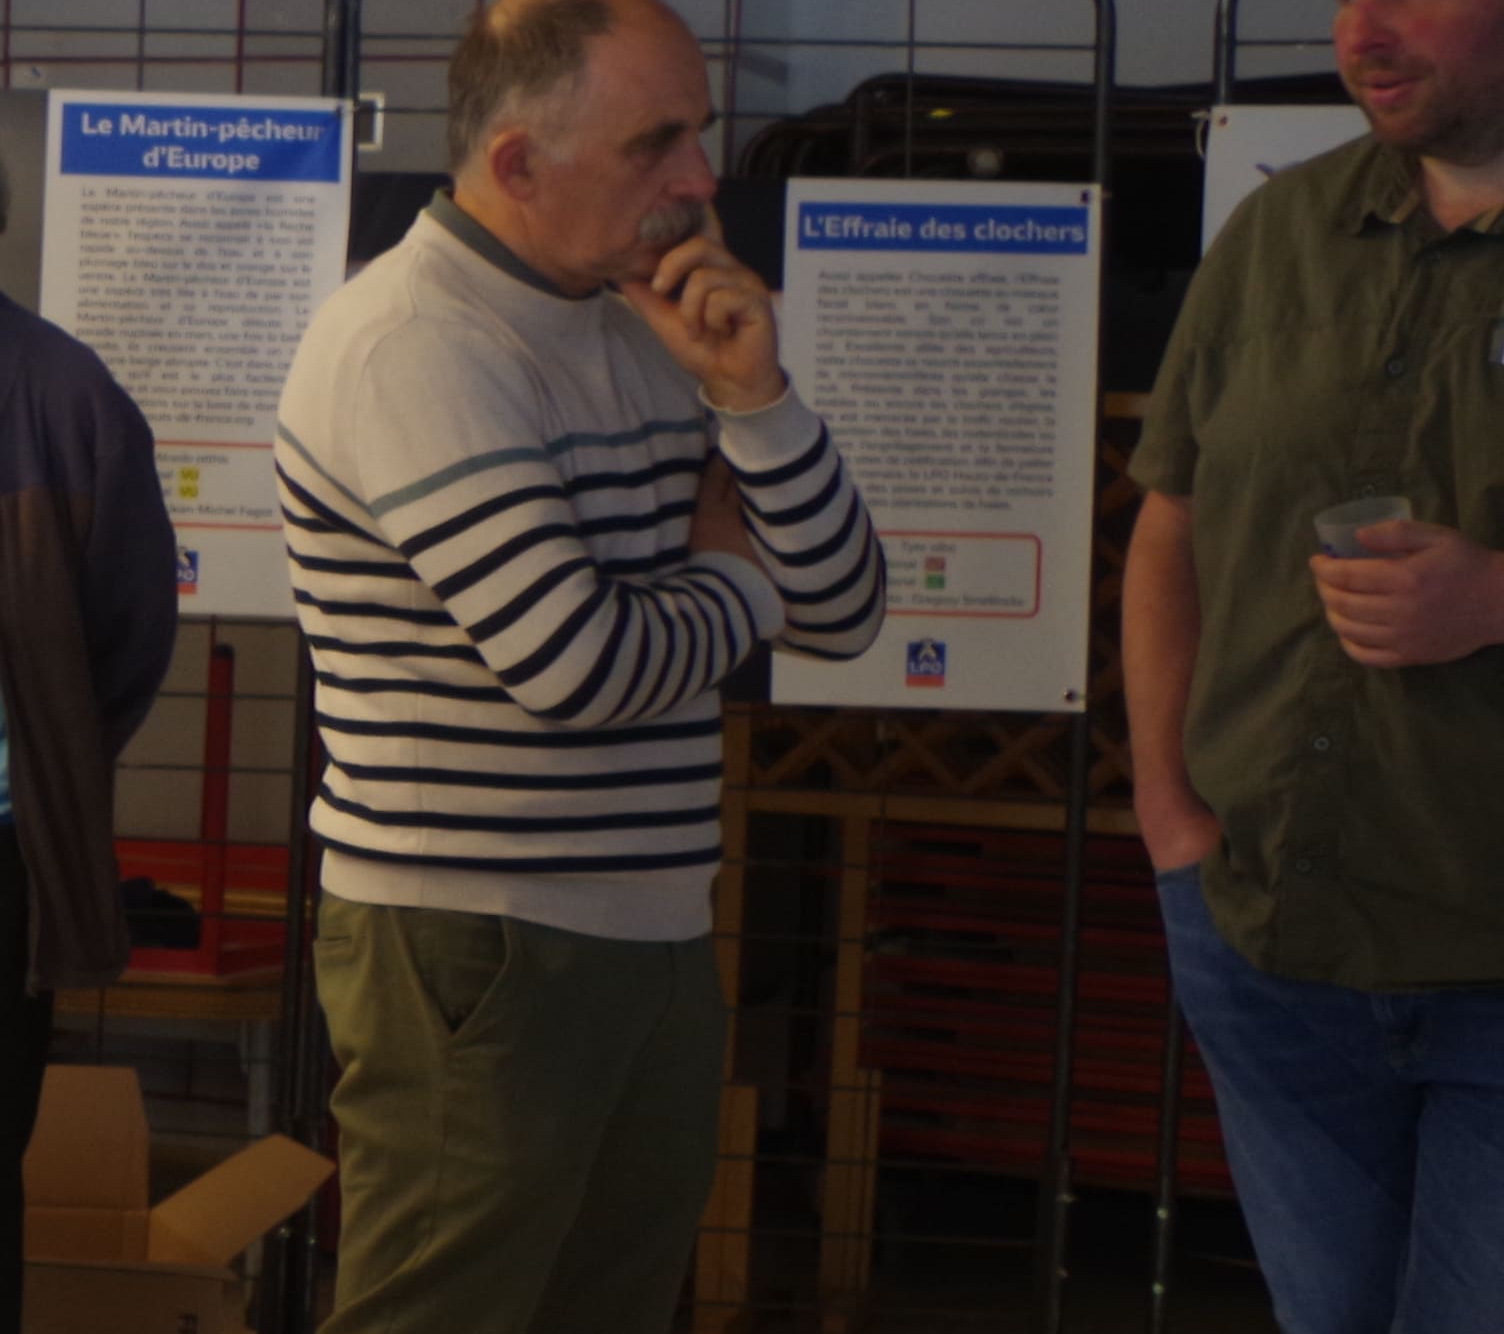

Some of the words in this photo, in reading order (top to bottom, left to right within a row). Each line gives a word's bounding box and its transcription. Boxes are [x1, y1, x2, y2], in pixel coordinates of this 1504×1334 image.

[82, 113, 112, 136] Le
[120, 114, 326, 144] Martin-pêcheur
[143, 147, 261, 172] d'Europe
[804, 215, 912, 241] L'Effraie
[919, 218, 967, 241] des
[974, 219, 1086, 244] clochers
